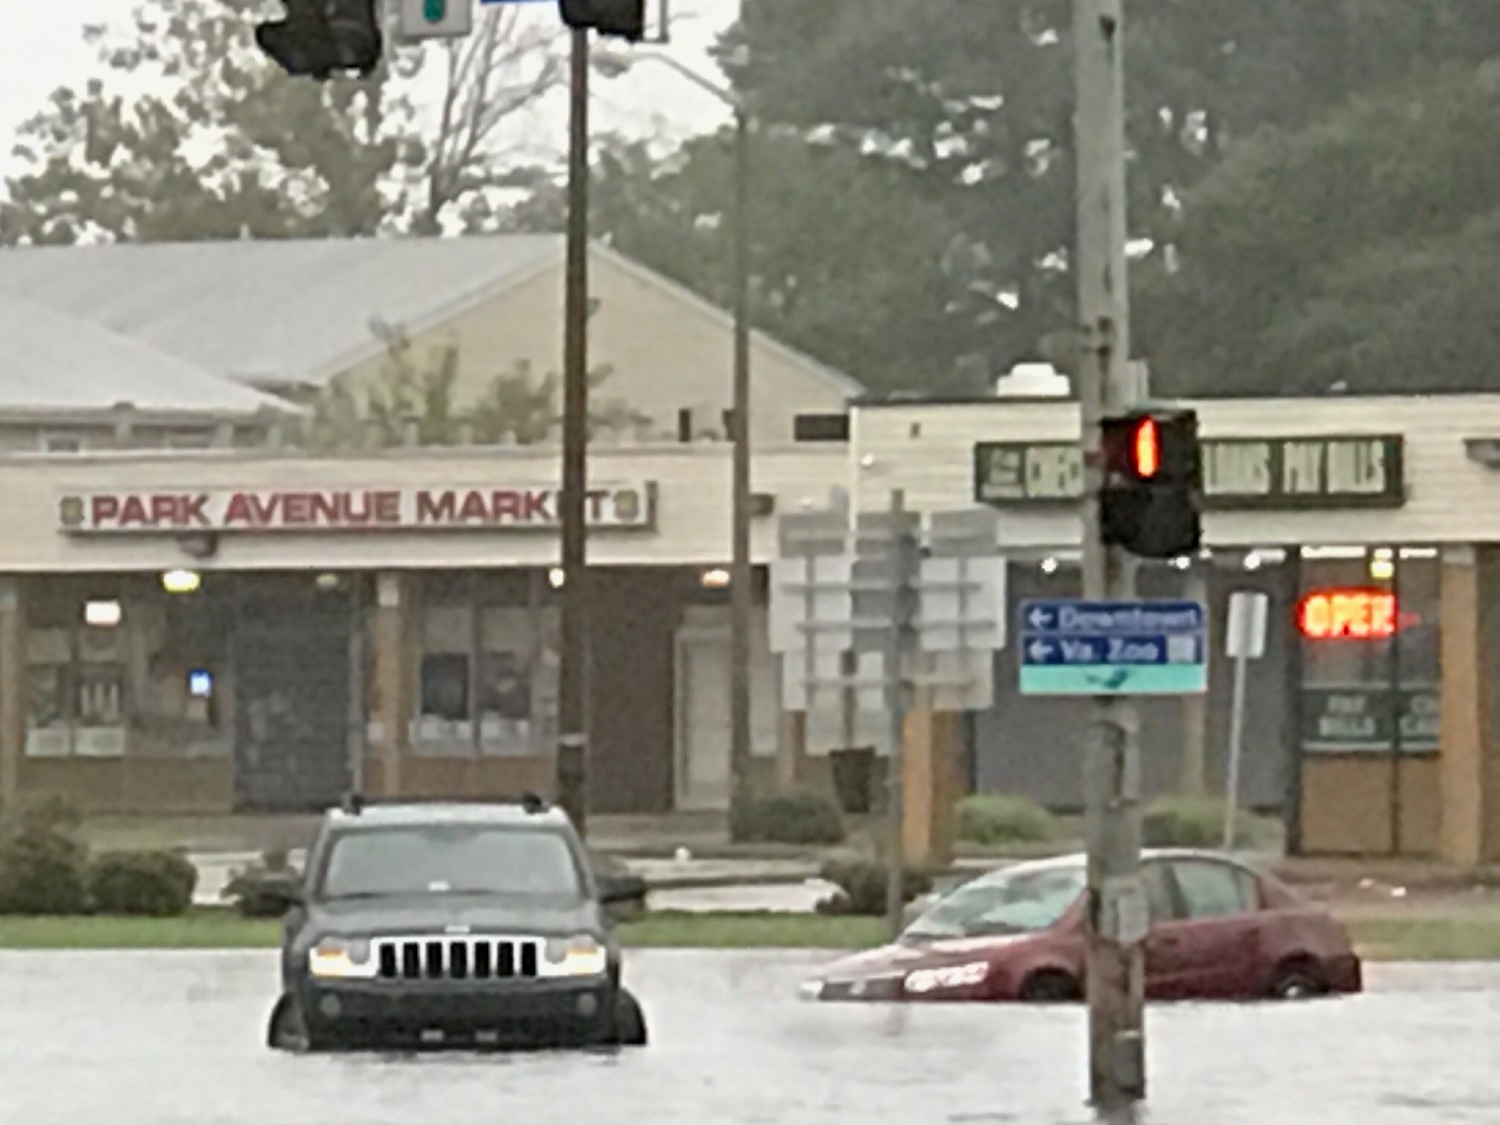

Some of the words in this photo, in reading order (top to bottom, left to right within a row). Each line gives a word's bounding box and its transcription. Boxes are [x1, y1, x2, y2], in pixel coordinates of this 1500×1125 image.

[92, 495, 212, 526] PARK
[223, 491, 400, 525] AVENUE
[415, 490, 609, 523] MARKT
[1059, 605, 1198, 627] Downtown
[1304, 593, 1396, 638] OPEN
[1107, 638, 1159, 661] Zoo
